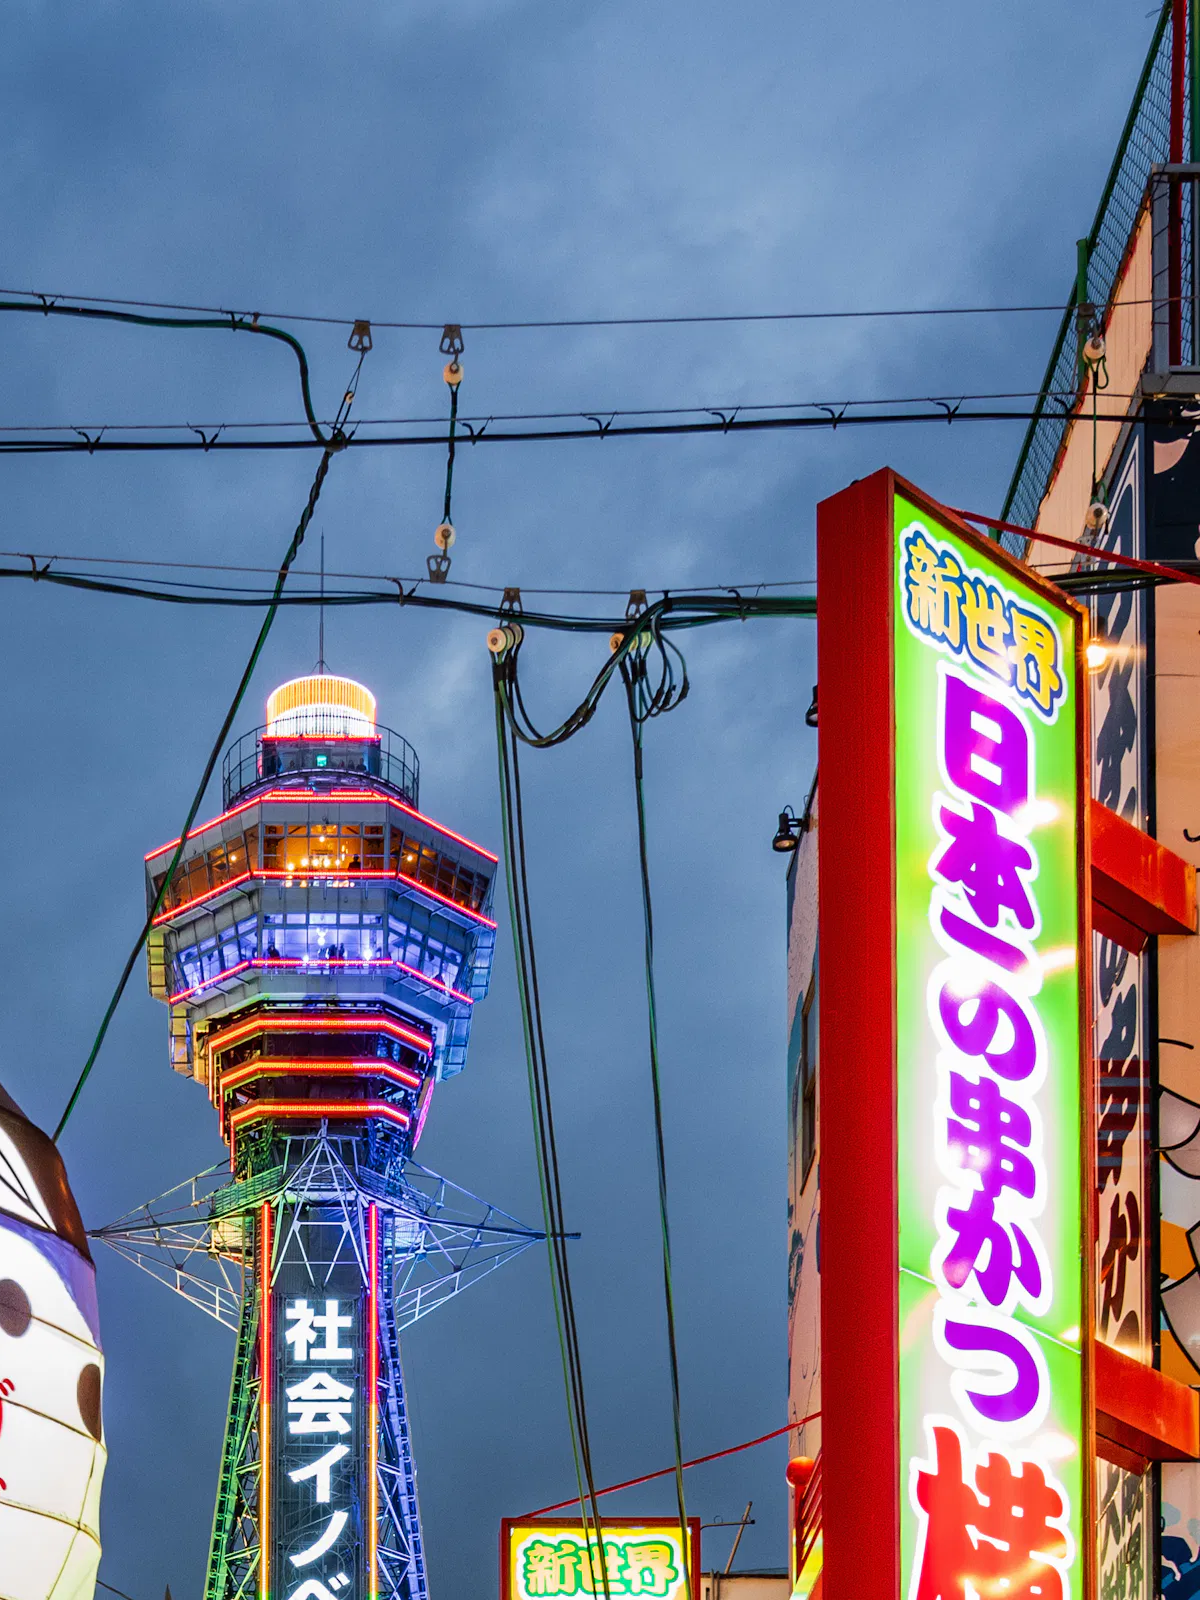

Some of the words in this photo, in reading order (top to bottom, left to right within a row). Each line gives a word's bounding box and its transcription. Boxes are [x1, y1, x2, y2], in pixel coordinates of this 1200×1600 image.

[905, 531, 1062, 714] 新世界
[940, 675, 1044, 1422] 日本一の串かつ
[524, 1539, 677, 1597] 新世界
